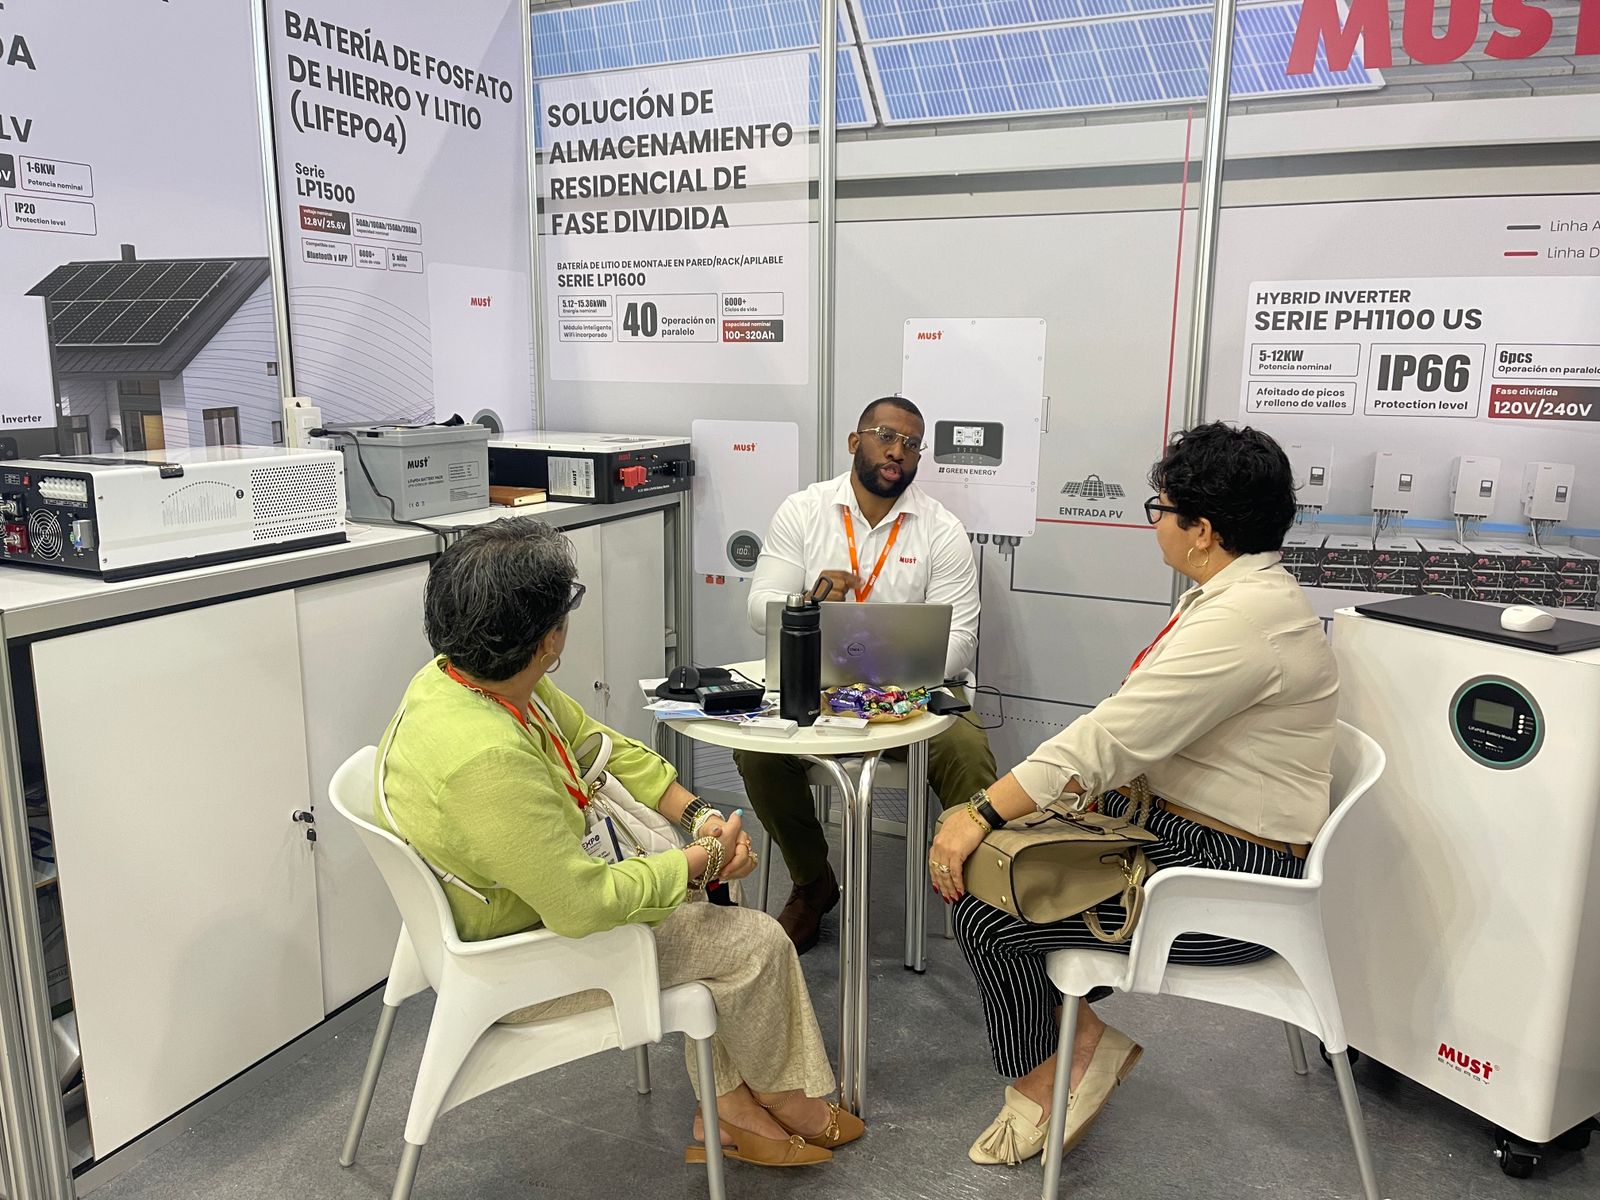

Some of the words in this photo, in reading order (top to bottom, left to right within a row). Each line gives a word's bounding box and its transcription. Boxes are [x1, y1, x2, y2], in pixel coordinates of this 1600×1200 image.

[0, 35, 36, 71] A
[285, 10, 388, 67] BATERÍA
[393, 44, 421, 77] DE
[425, 55, 513, 103] FOSFATO
[288, 54, 321, 88] DE
[327, 65, 411, 111] HIERRO
[415, 90, 429, 116] Y
[435, 96, 481, 130] LITIO
[547, 88, 674, 128] SOLUCIÓN
[681, 89, 714, 116] DE
[290, 89, 407, 154] (LIFEPO4)
[549, 121, 793, 164] ALMACENAMIENTO
[26, 161, 56, 175] 1-6KW
[295, 162, 325, 179] Serie
[0, 169, 11, 182] V
[28, 178, 57, 188] Potencia
[57, 183, 84, 191] nominal
[550, 168, 708, 200] RESIDENCIAL
[713, 165, 747, 191] DE
[296, 177, 356, 204] LP1500
[14, 201, 36, 215] IP20
[15, 215, 50, 225] Protection
[50, 218, 67, 227] level
[326, 220, 347, 231] 25.6V
[551, 211, 609, 236] FASE
[614, 205, 730, 233] DIVIDIDA
[1550, 220, 1588, 232] Linha
[306, 250, 333, 261] Bluetooth
[1547, 246, 1585, 258] Linha
[557, 258, 589, 270] BATERÍA
[590, 261, 601, 270] DE
[601, 260, 621, 269] LITIO
[621, 260, 632, 269] DE
[633, 259, 672, 269] MONTAJE
[673, 258, 685, 267] EN
[685, 254, 784, 268] PARED/RACK/APILABLE
[558, 273, 595, 287] SERIE
[597, 272, 646, 287] LP1600
[470, 295, 491, 307] MUST
[562, 299, 607, 308] 5.12-15.36kWh
[724, 297, 747, 306] 6000+
[1256, 291, 1321, 305] HYBRID
[1324, 289, 1411, 304] INVERTER
[622, 301, 658, 338] 40
[661, 316, 704, 327] Operación
[704, 317, 716, 325] en
[1254, 309, 1328, 331] SERIE
[1334, 308, 1435, 330] PH1100
[1442, 308, 1483, 330] US
[583, 324, 612, 332] inteligente
[661, 327, 695, 338] paralelo
[724, 330, 775, 340] 100-320Ah
[917, 330, 943, 341] MUST
[1259, 349, 1304, 362] 5-12KW
[1499, 350, 1533, 364] 6pcs
[1296, 363, 1332, 371] nominal
[1377, 353, 1471, 392] IP66
[1498, 364, 1548, 374] Operación
[1256, 387, 1300, 396] Afeitado
[1301, 388, 1315, 397] de
[1316, 388, 1345, 399] picos
[1495, 387, 1518, 395] Fase
[1519, 387, 1558, 396] dividida
[1255, 400, 1262, 409] y
[1263, 399, 1299, 407] relleno
[1300, 399, 1314, 408] de
[1316, 399, 1347, 408] valles
[1374, 399, 1437, 410] Protection
[1438, 400, 1468, 411] level
[1493, 399, 1592, 418] 120V/240V
[2, 415, 42, 424] Inverter
[733, 442, 757, 452] MUST
[407, 456, 429, 469] MUST
[945, 467, 968, 475] GREEN
[969, 468, 997, 476] ENERGY
[1059, 507, 1107, 518] ENTRADA
[1108, 510, 1124, 519] PV
[899, 556, 917, 564] MUST
[1437, 1042, 1494, 1080] MUST
